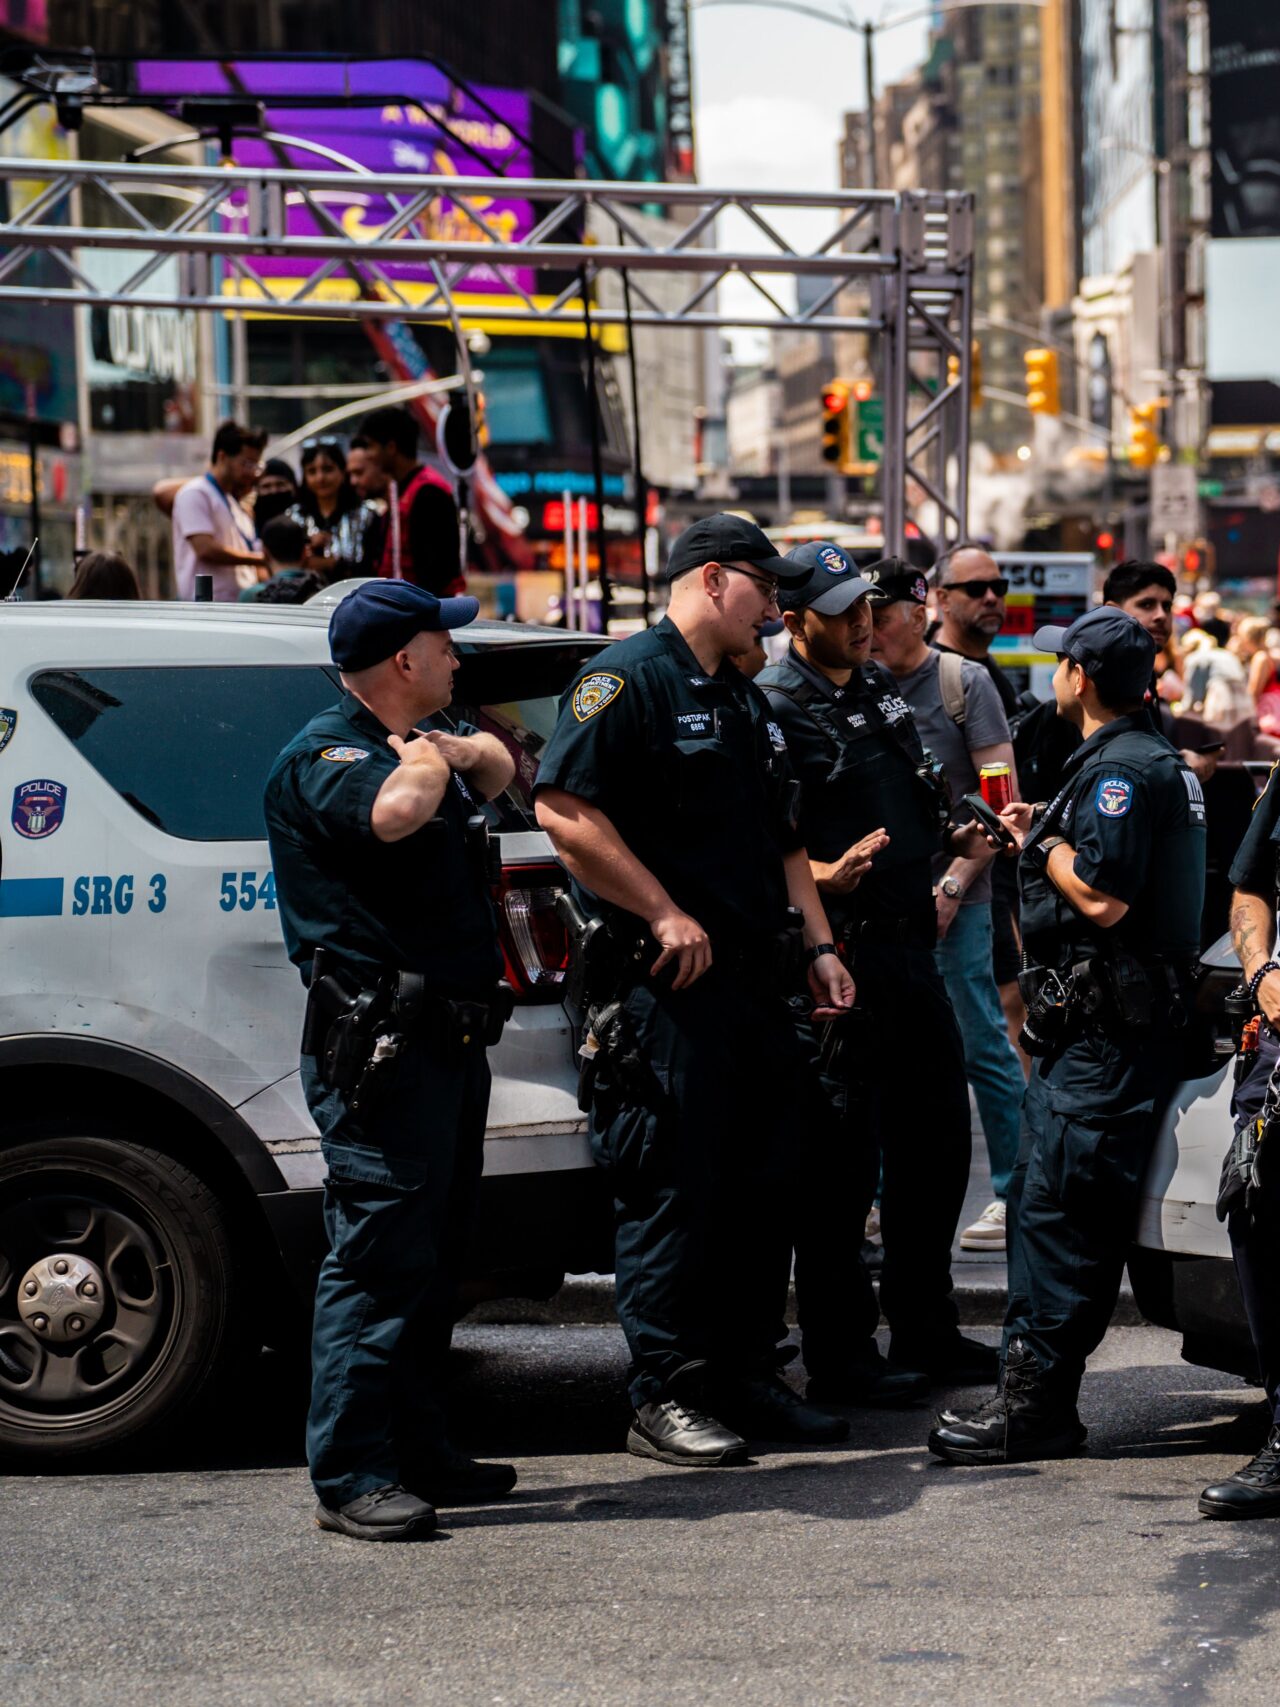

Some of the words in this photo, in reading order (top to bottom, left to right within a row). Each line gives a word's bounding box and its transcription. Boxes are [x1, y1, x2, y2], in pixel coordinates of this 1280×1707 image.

[877, 697, 907, 714] POLICE
[677, 713, 711, 724] POSTUPAK
[20, 781, 62, 797] POLICE
[1103, 780, 1130, 793] POLICE
[72, 875, 134, 916] SRG
[148, 873, 167, 914] 3
